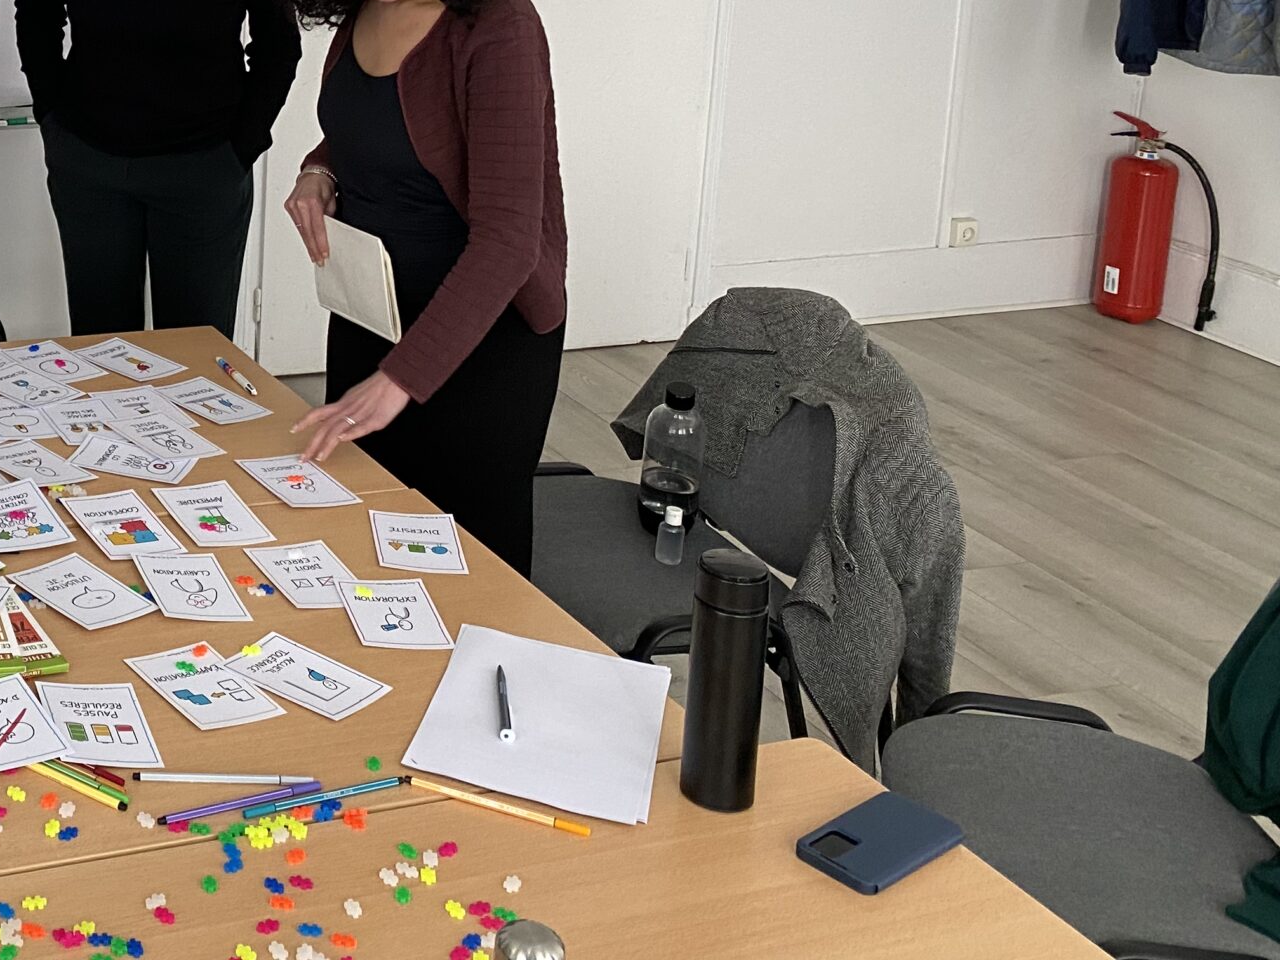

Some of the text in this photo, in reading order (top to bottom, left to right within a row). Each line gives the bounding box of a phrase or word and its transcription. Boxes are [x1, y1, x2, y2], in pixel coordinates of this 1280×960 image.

[117, 395, 147, 404] CALME
[135, 424, 169, 433] RESPECT
[176, 496, 223, 506] APPRENDRE
[295, 562, 322, 571] DROIT
[153, 568, 211, 577] CLARIFICATION
[47, 575, 92, 592] UTILISATION
[353, 595, 417, 603] EXPLORATION
[73, 709, 119, 719] PAUSES
